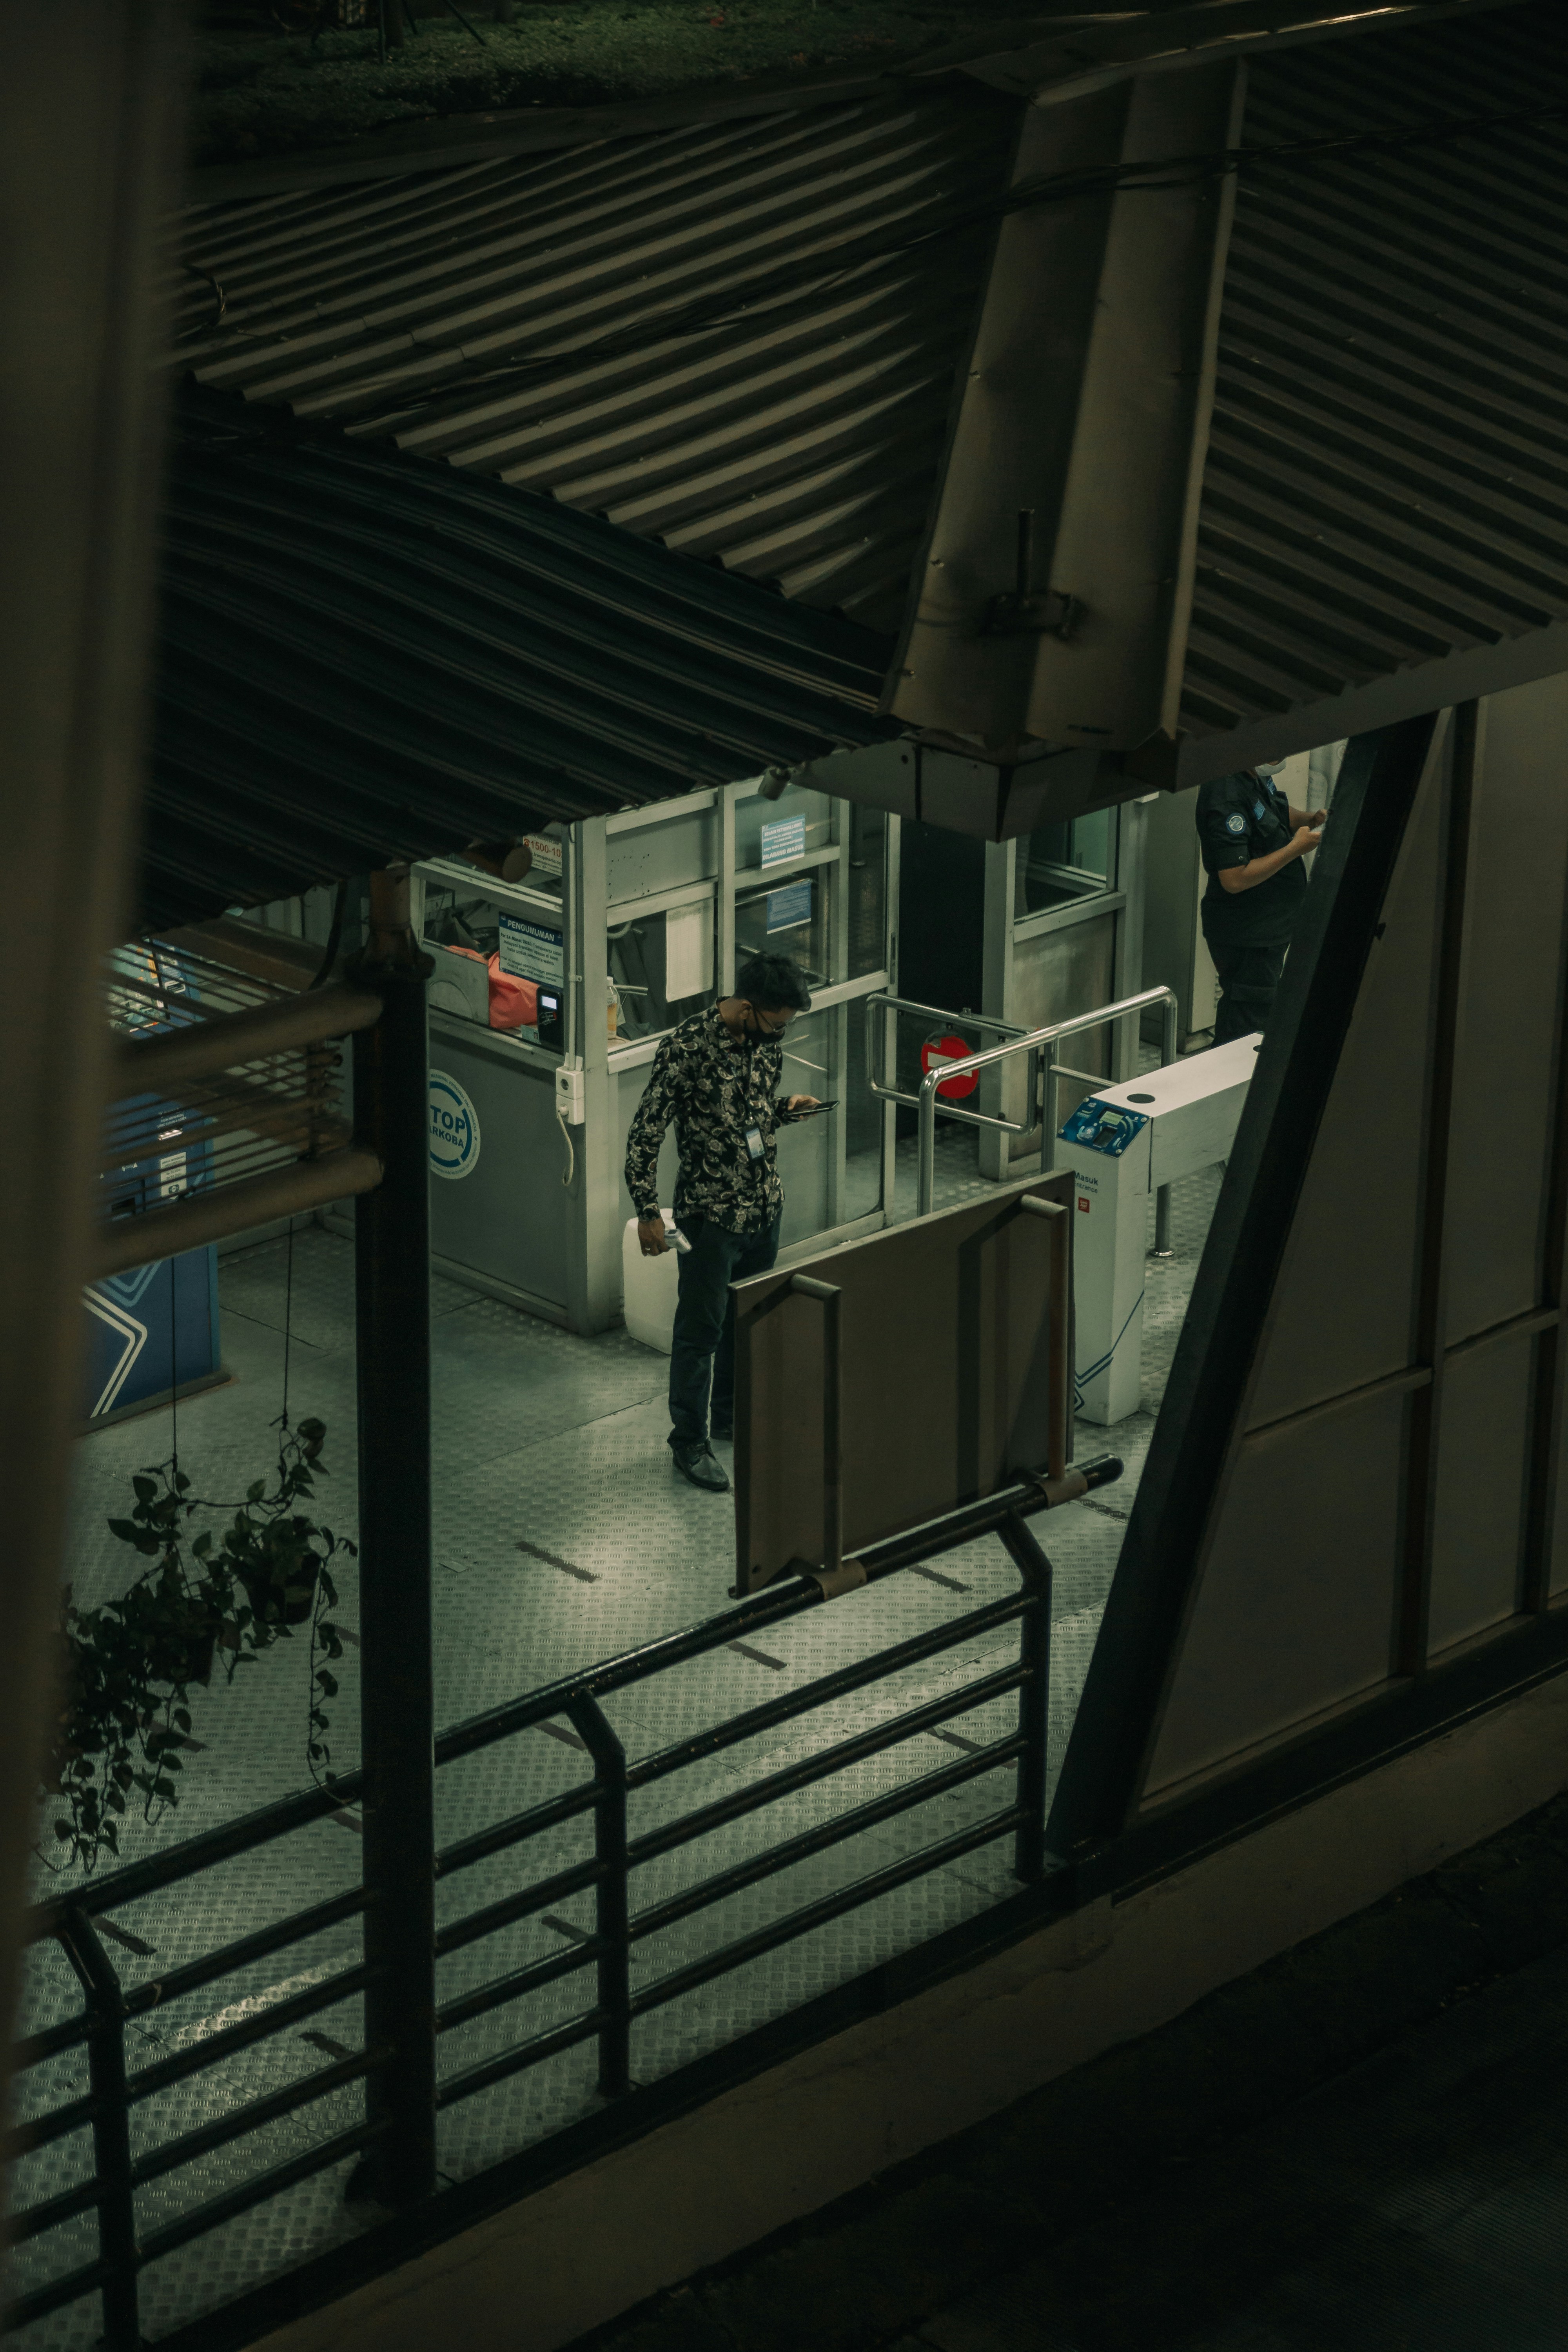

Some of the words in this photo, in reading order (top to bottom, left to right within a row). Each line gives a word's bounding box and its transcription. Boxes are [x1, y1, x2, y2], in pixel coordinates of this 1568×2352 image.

[531, 840, 561, 857] 1500-10
[762, 849, 786, 860] DILARANG
[787, 844, 803, 853] MASUK
[508, 920, 554, 942] PENGUMUMAN
[430, 1104, 466, 1134] TOP
[430, 1123, 464, 1149] RKOBA
[1074, 1172, 1098, 1186] Masuk
[1074, 1183, 1098, 1194] ntrance
